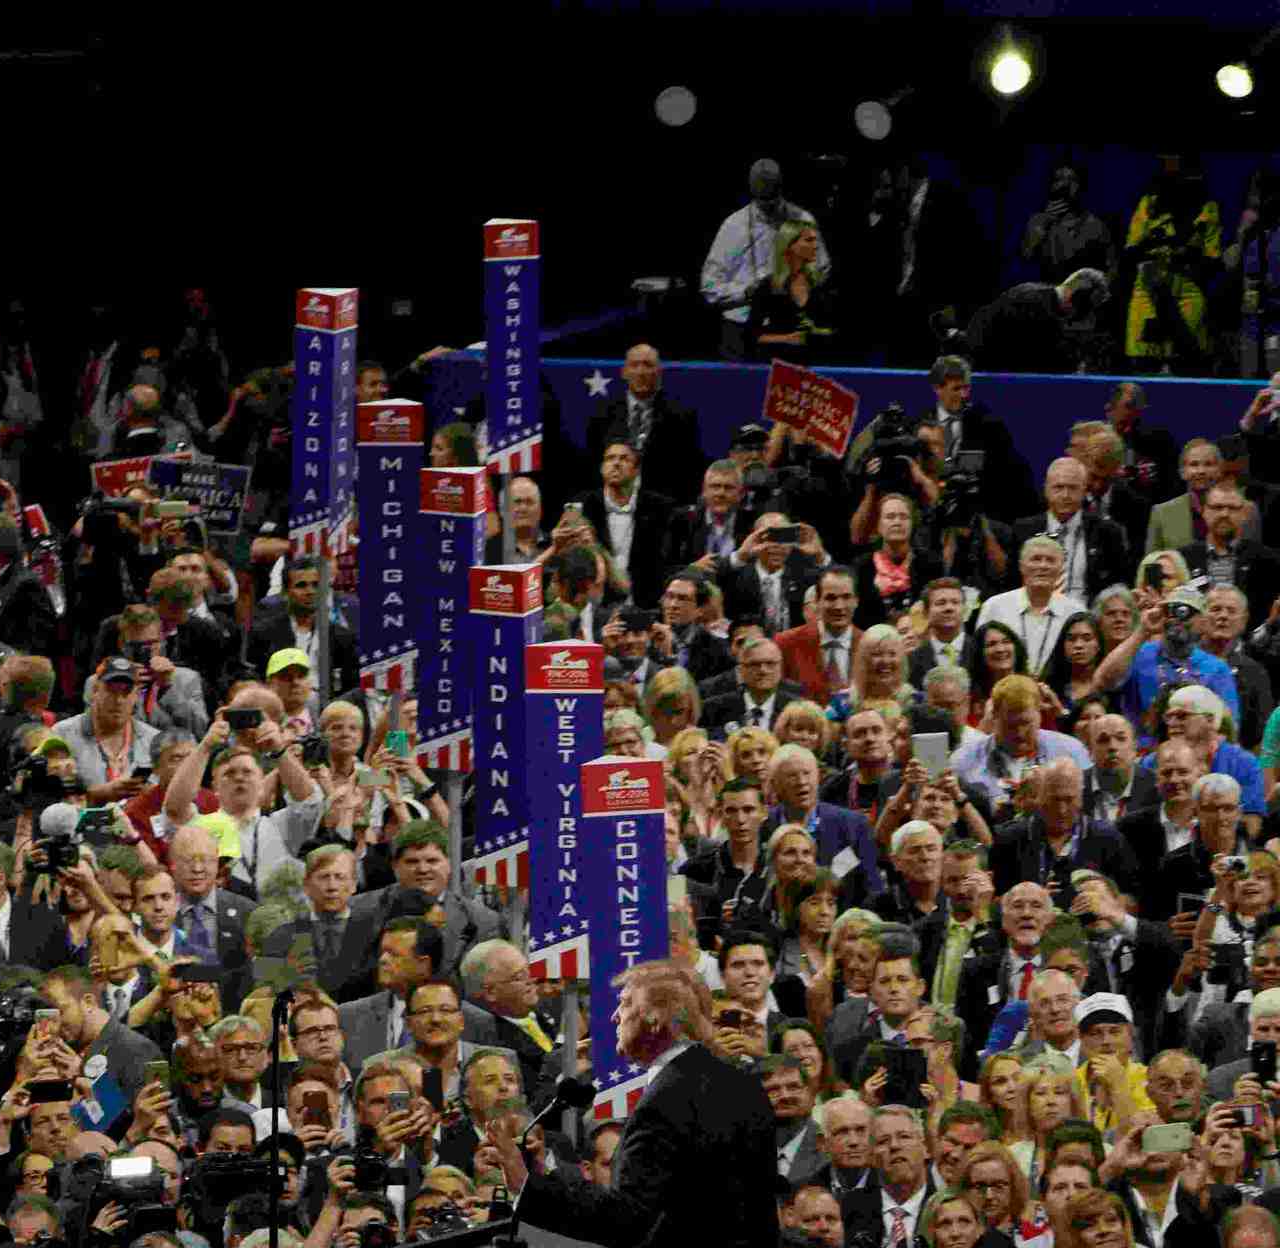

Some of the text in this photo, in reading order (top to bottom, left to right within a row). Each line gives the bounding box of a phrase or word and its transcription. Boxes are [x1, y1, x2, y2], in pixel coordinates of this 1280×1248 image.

[303, 335, 323, 502] ARIZONA
[503, 264, 523, 426] WASHINGTON
[379, 455, 405, 629] MICHIGAN
[437, 518, 458, 576] NEW
[436, 597, 456, 714] MEXICO
[489, 627, 511, 817] INDIANA
[554, 697, 579, 918] WEST VIRGINIA
